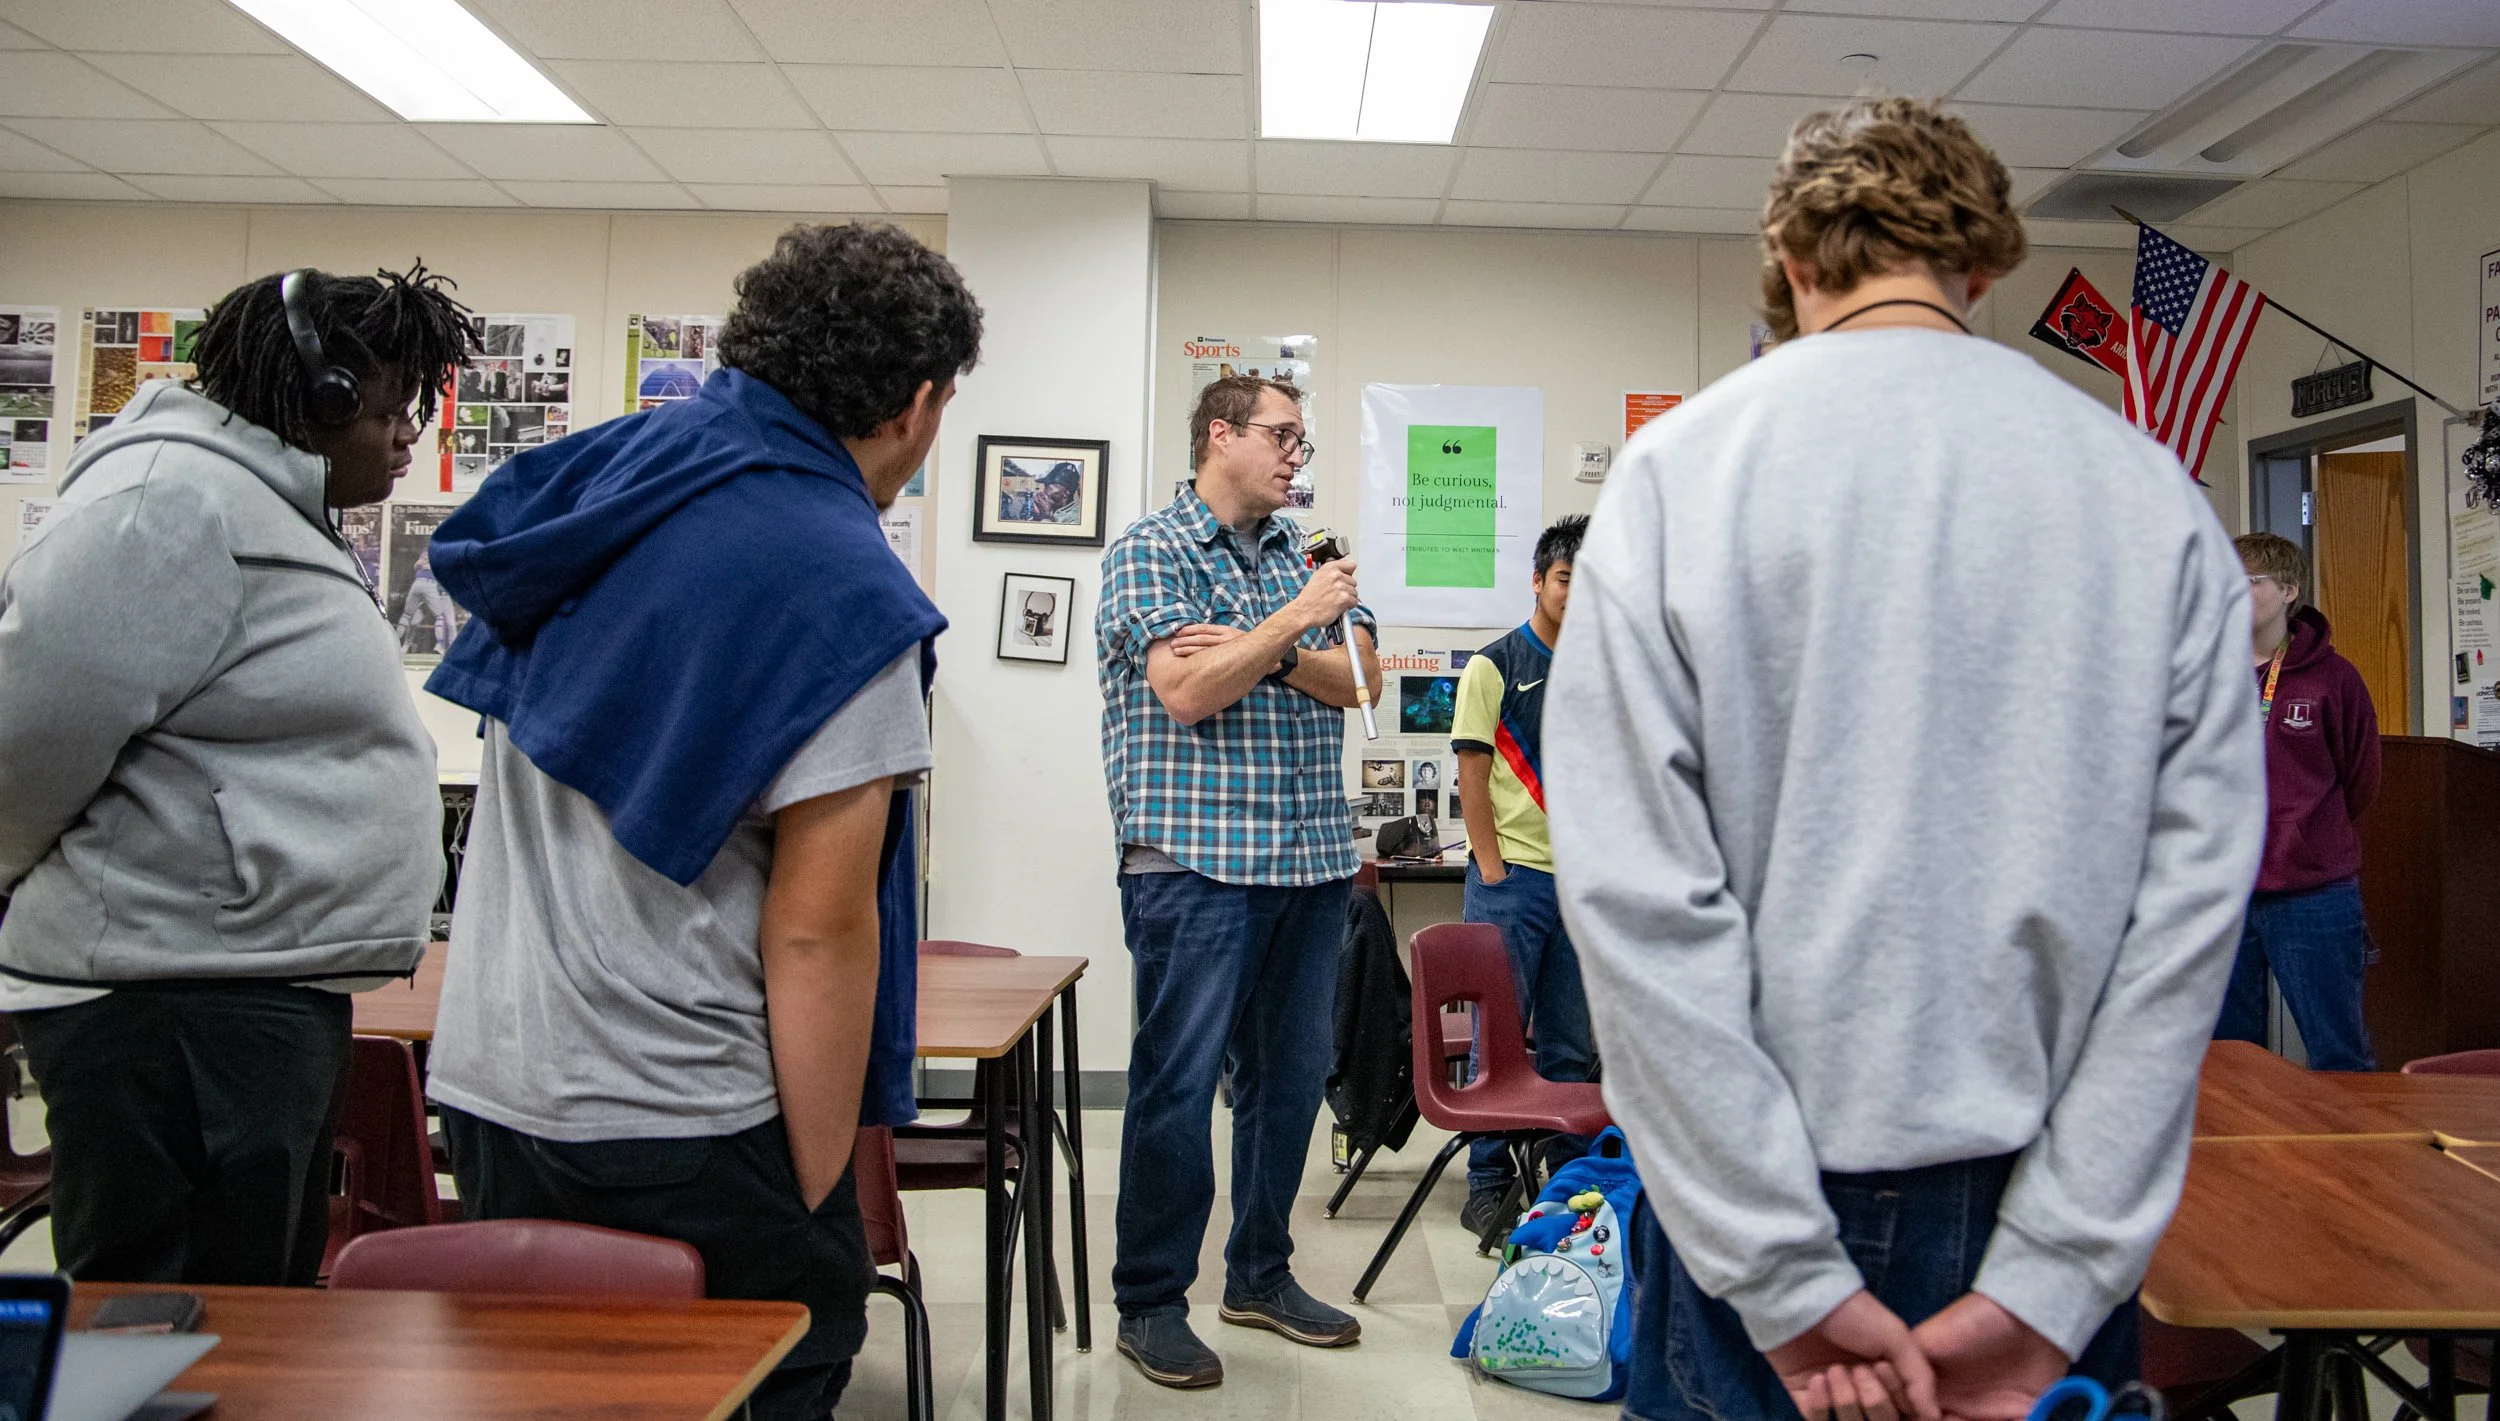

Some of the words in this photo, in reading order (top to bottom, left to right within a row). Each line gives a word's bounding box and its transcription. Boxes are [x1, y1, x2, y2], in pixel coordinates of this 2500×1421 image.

[2488, 261, 2500, 279] FA
[2486, 305, 2500, 323] PA
[1184, 341, 1240, 360] Sports
[2295, 369, 2361, 410] MORGUE
[1412, 473, 1430, 486] Be
[1433, 474, 1492, 489] curious,
[1392, 496, 1415, 507] not
[1418, 494, 1507, 512] judgmental.
[404, 521, 441, 535] Fina
[891, 520, 910, 528] security
[1377, 652, 1440, 672] ghting
[2292, 705, 2303, 721] L
